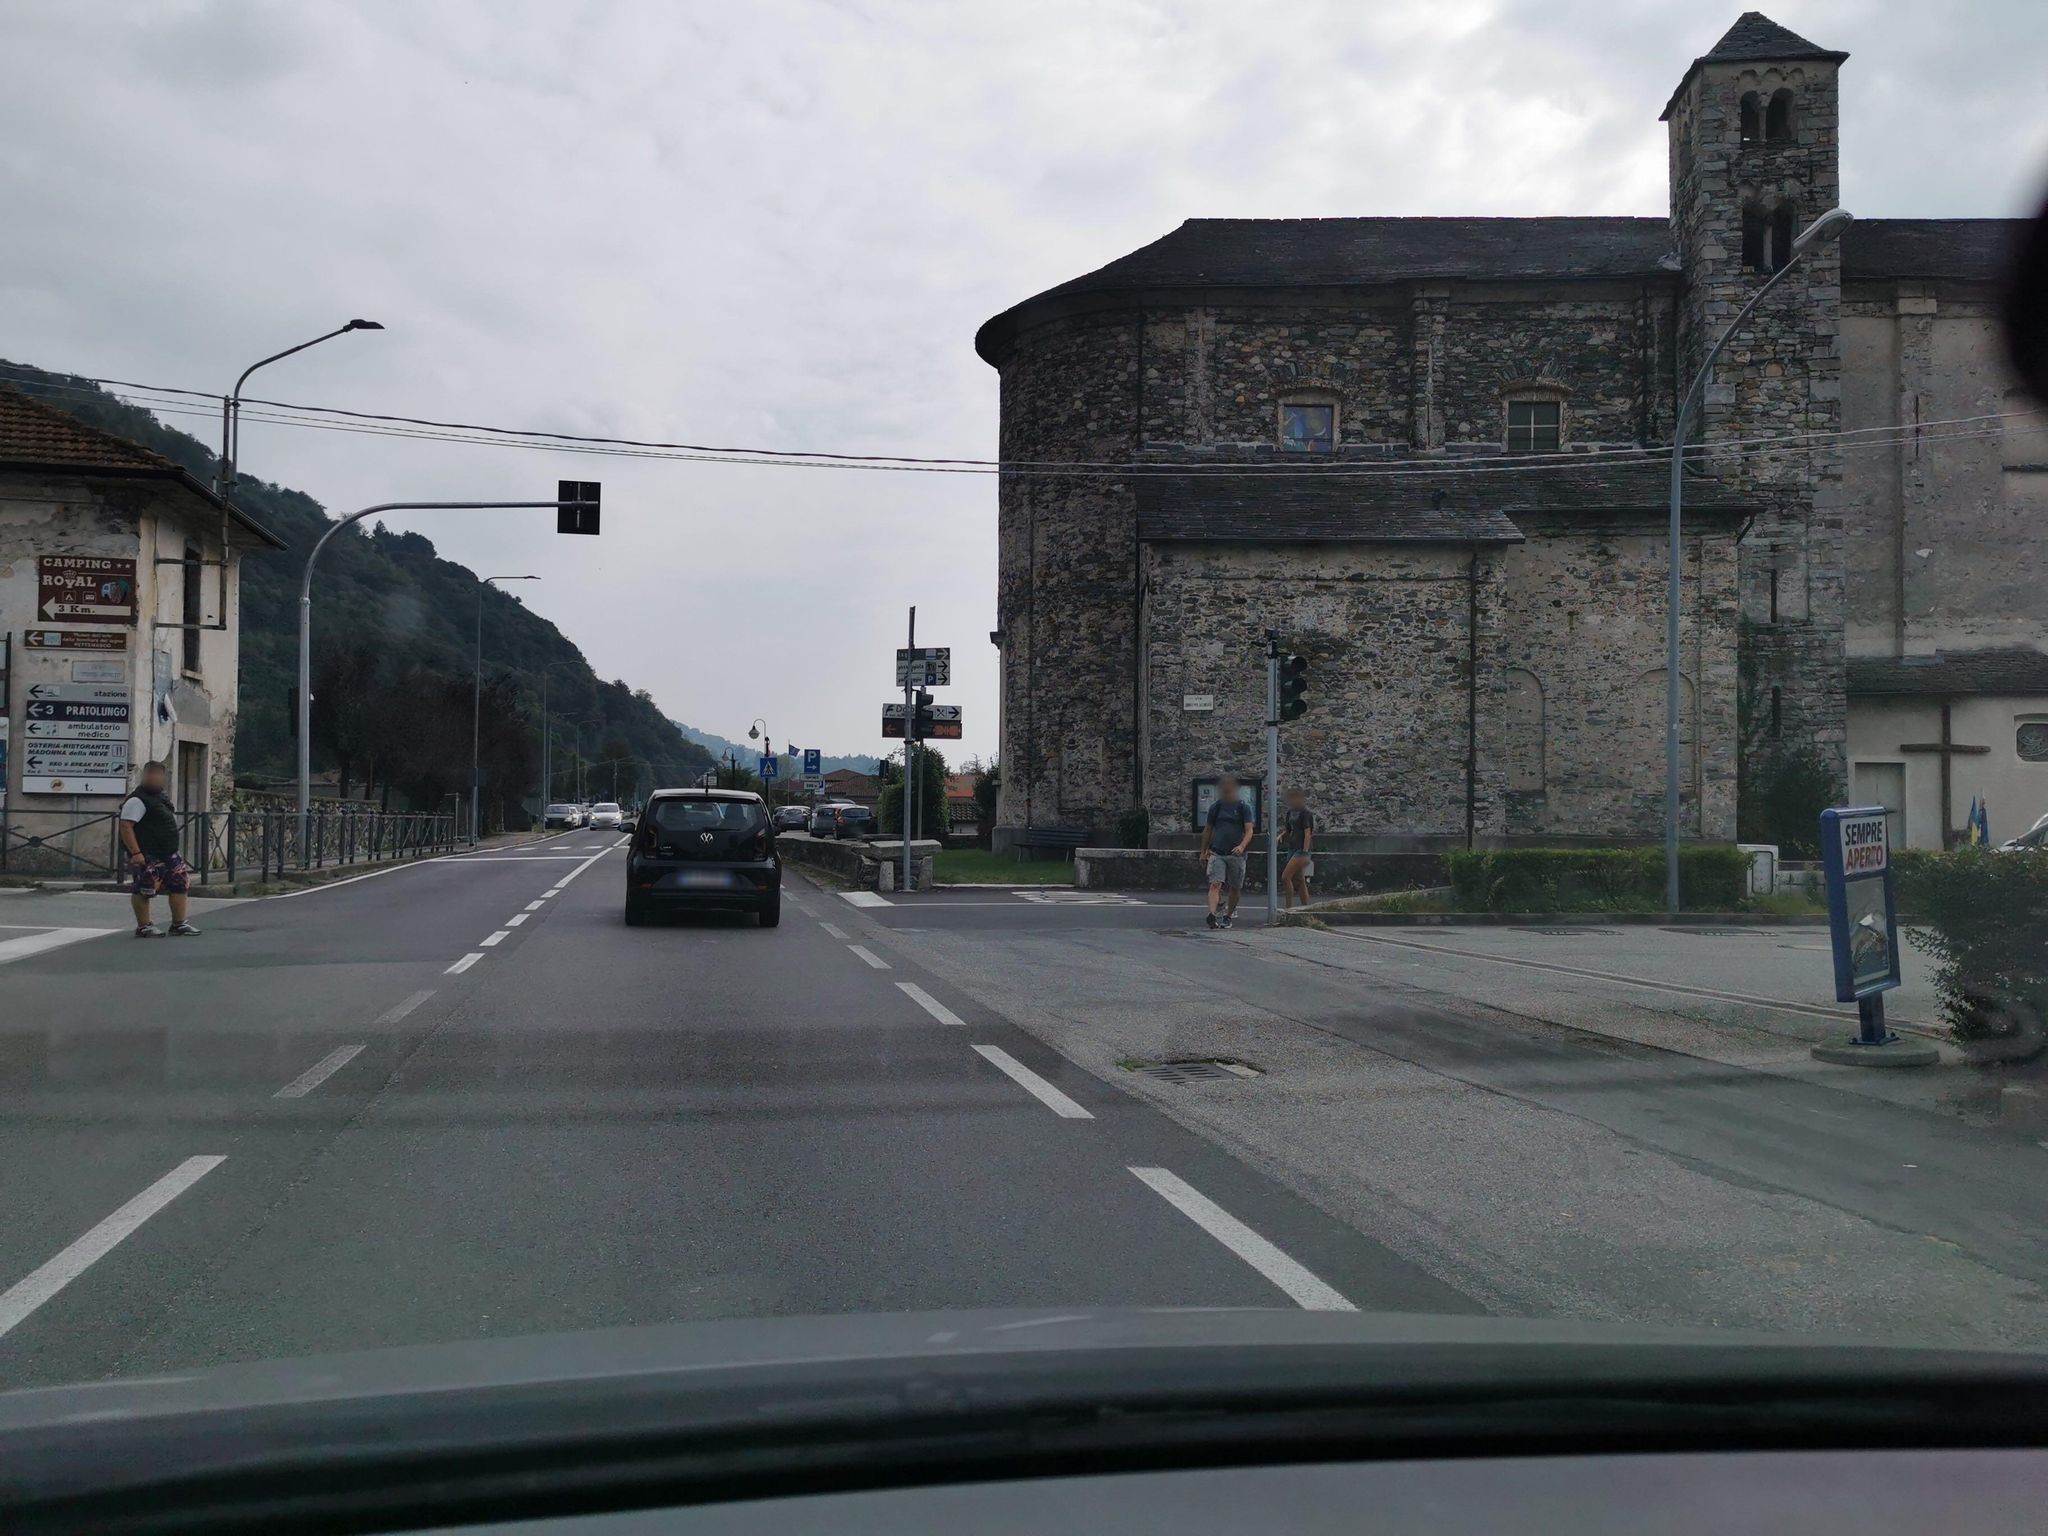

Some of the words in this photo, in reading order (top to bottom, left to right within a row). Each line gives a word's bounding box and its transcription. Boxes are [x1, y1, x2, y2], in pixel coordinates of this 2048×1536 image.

[43, 558, 112, 569] CAMPING
[70, 605, 95, 614] Km.
[94, 689, 127, 698] stazione
[46, 705, 54, 715] 3
[66, 706, 127, 717] PRATOLUNGO
[67, 723, 120, 731] ambulatorio
[808, 751, 817, 763] P
[1845, 821, 1883, 846] SEMPRE
